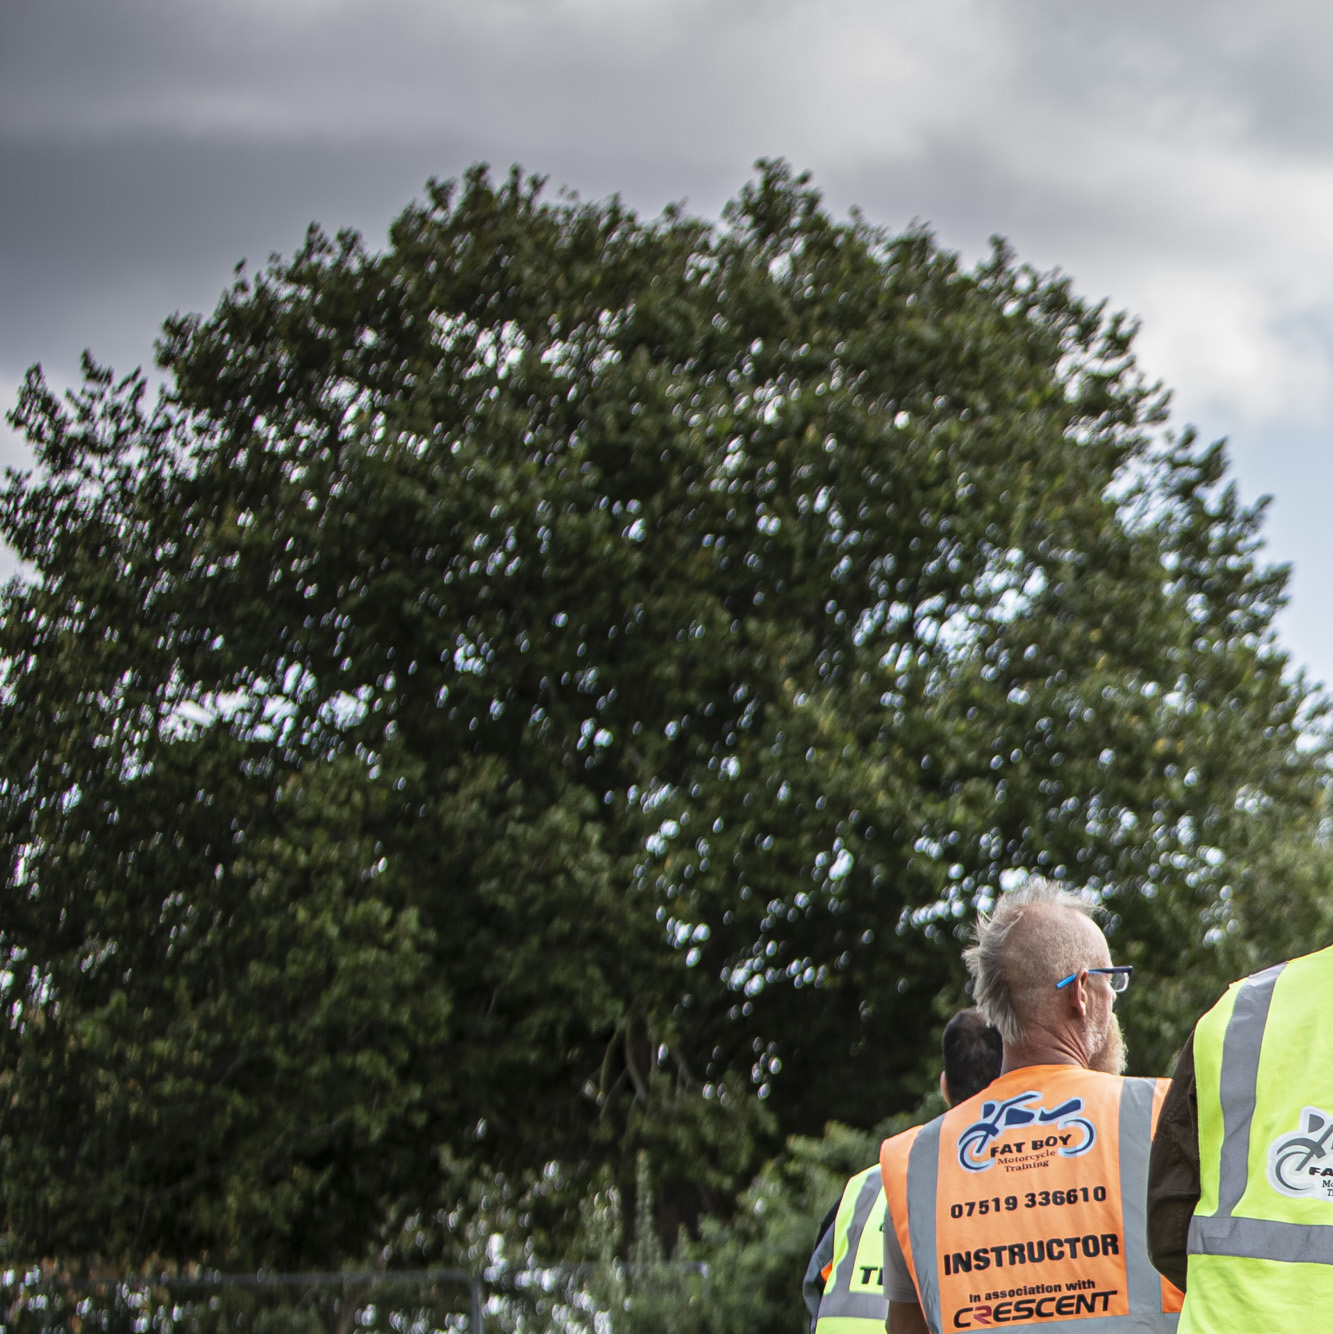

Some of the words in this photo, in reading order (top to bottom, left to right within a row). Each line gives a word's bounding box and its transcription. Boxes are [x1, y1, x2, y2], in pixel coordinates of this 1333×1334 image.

[990, 1141, 1028, 1158] FAT
[1031, 1133, 1073, 1151] BOY
[997, 1149, 1057, 1166] Motorcycle
[1004, 1159, 1050, 1173] Training
[950, 1196, 1019, 1219] 07519
[1024, 1186, 1107, 1209] 336610
[944, 1233, 1119, 1276] INSTRUCTOR
[969, 1292, 980, 1304] In
[983, 1281, 1063, 1302] association
[1065, 1278, 1096, 1295] with
[953, 1290, 1118, 1328] CRESCENT
